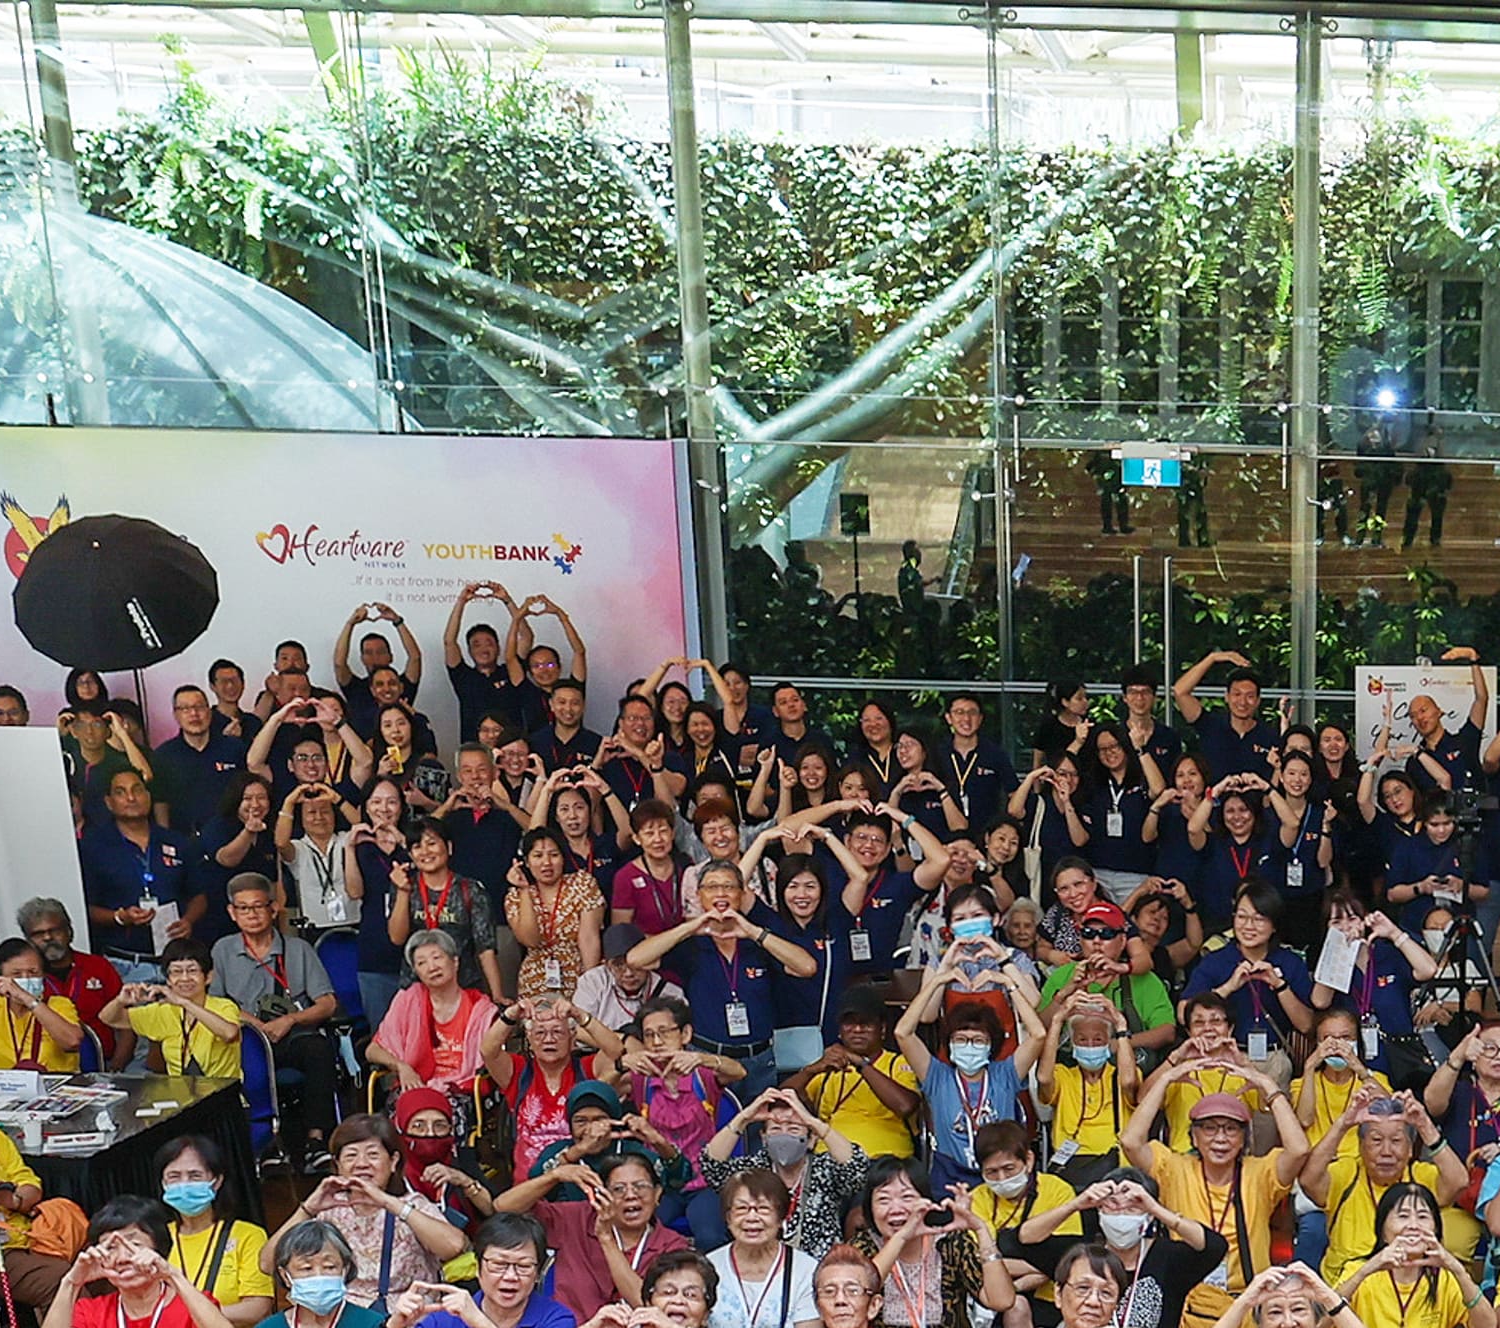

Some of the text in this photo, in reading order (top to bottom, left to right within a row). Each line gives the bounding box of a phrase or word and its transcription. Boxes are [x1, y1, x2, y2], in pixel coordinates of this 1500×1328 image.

[286, 524, 405, 567] Heartware
[422, 543, 551, 562] YOUTHBANK
[364, 560, 407, 569] NETWORK
